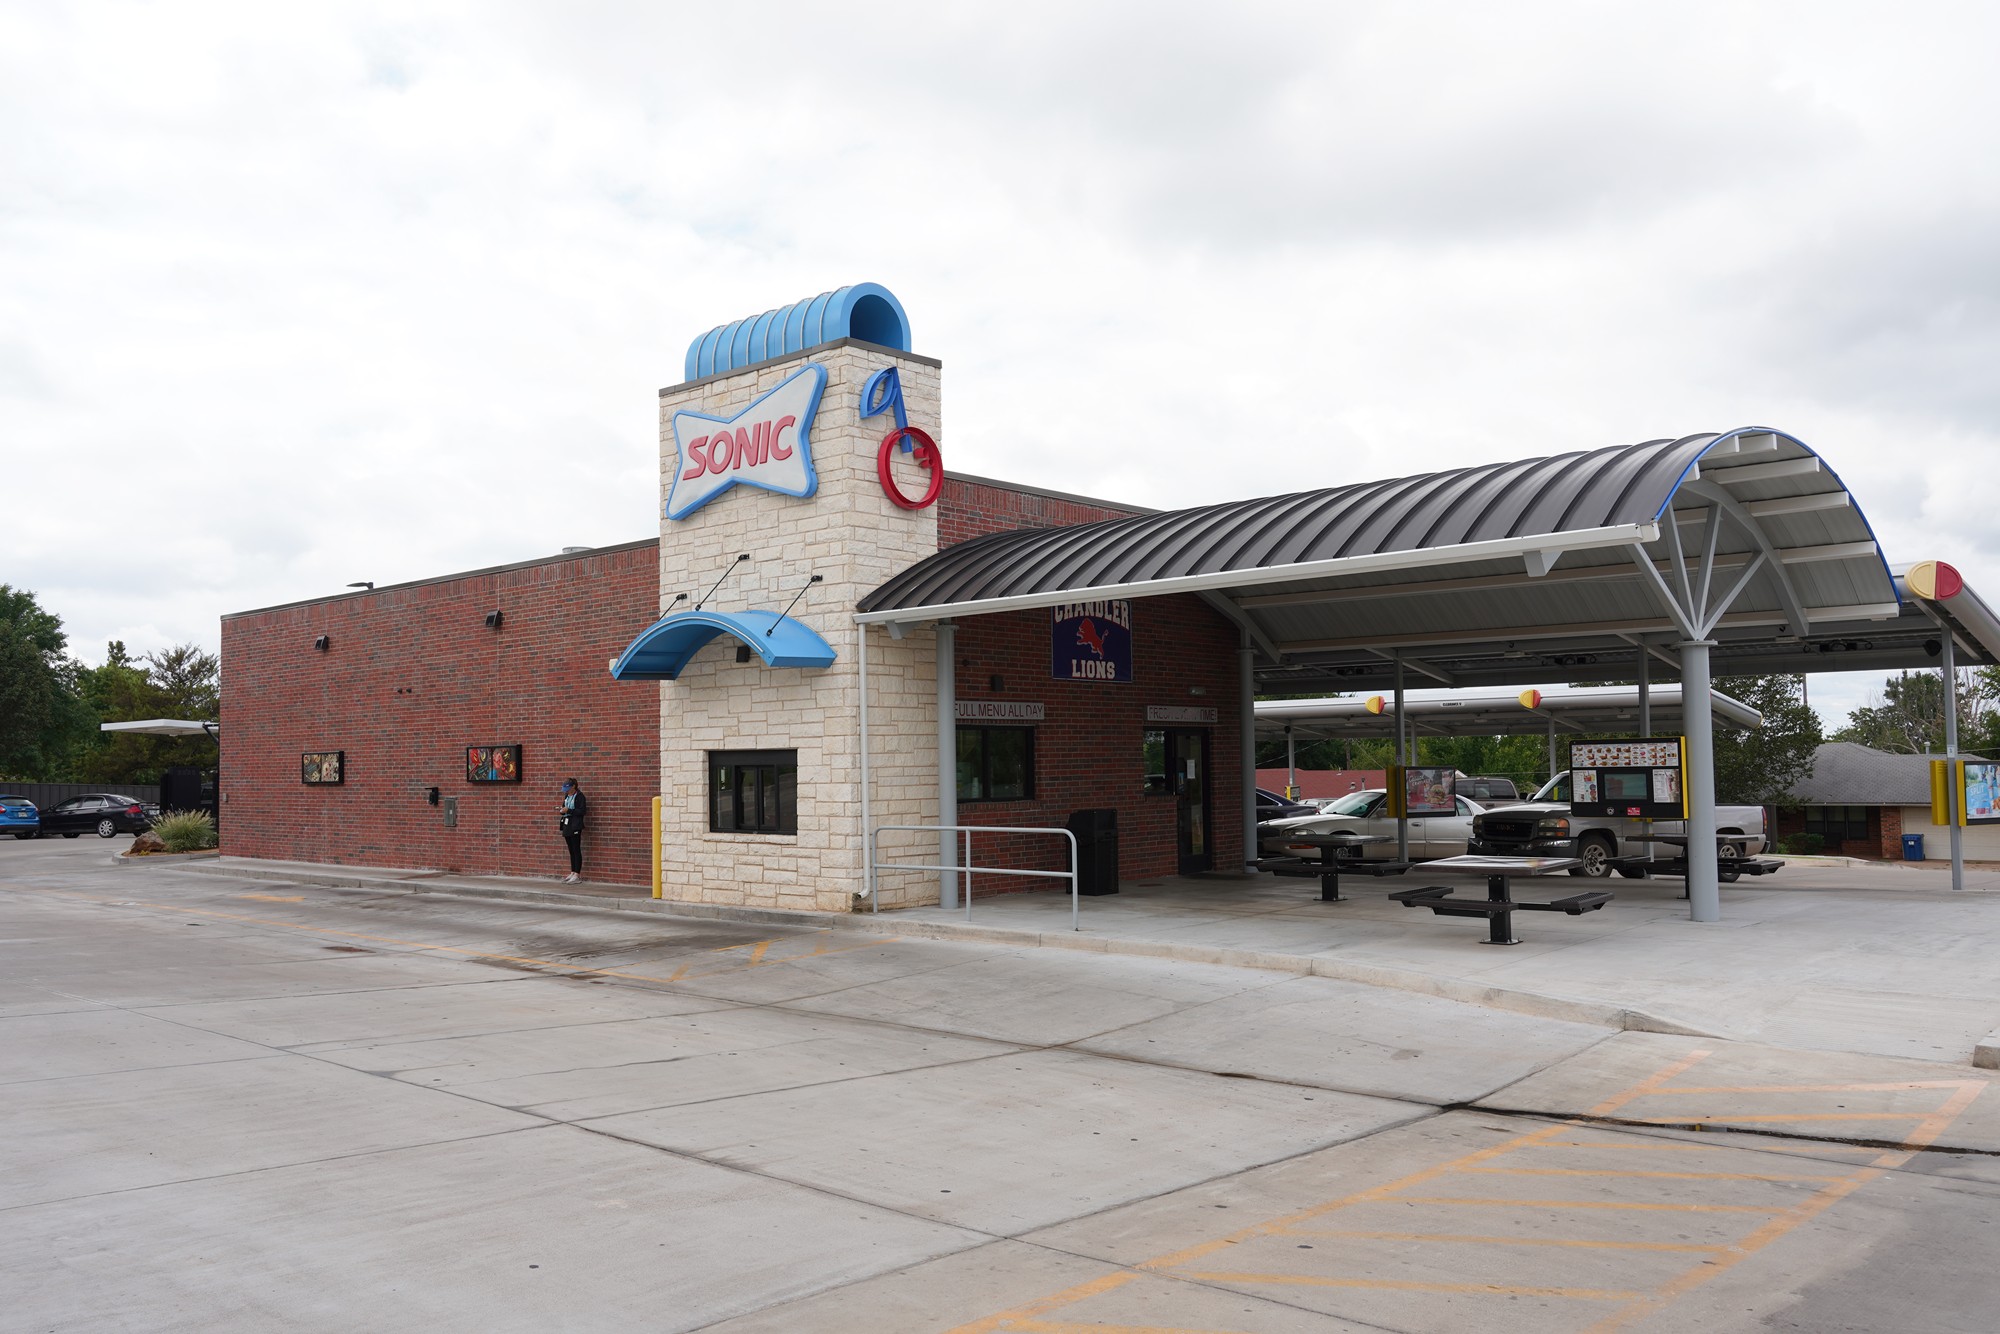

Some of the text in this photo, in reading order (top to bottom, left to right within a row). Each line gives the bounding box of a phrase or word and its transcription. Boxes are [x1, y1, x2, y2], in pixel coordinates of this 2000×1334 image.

[682, 415, 796, 481] SONIC
[1054, 600, 1130, 631] CHANDLER
[1071, 659, 1116, 680] LIONS
[978, 703, 1006, 717] MENU
[1008, 704, 1024, 718] ALL
[1025, 705, 1044, 718] DAY
